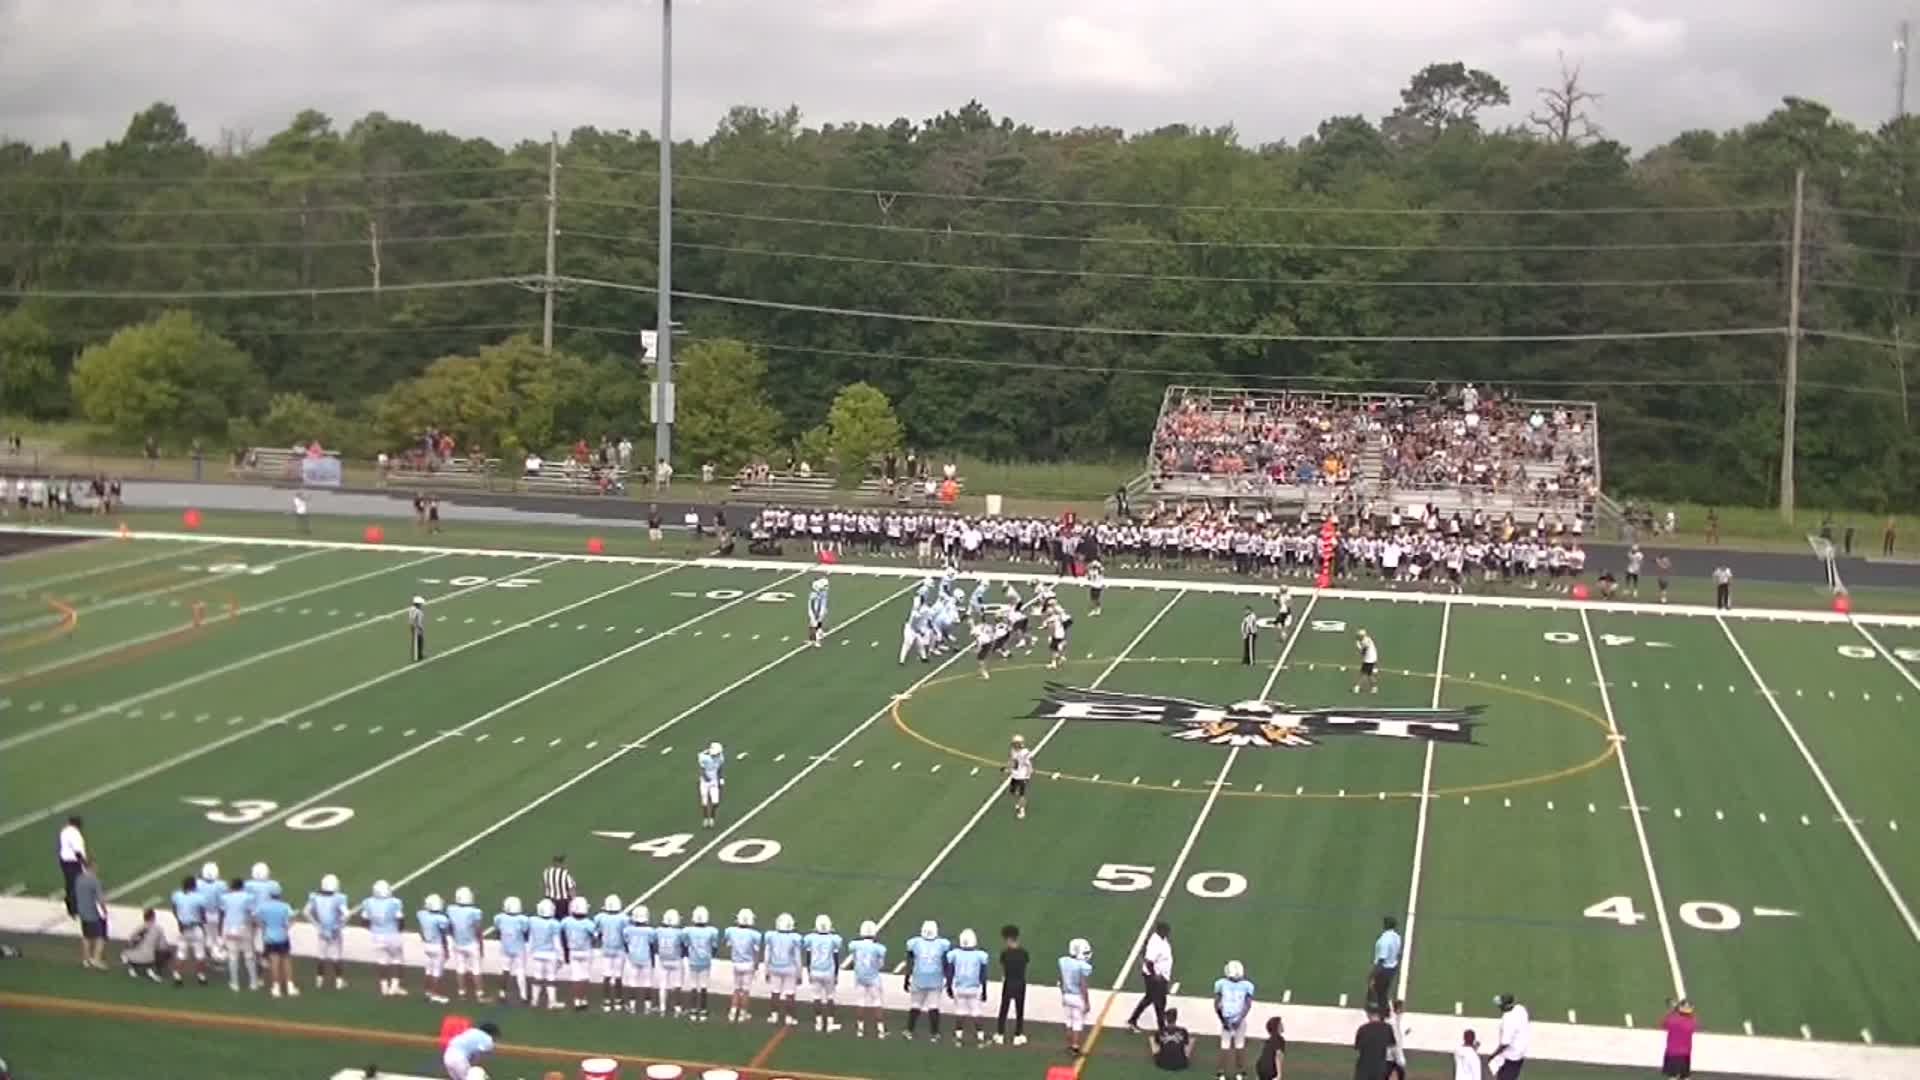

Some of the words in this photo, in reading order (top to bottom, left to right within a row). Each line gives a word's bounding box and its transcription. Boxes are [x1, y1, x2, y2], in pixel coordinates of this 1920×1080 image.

[206, 800, 354, 832] 30
[629, 833, 781, 865] 40
[1092, 863, 1248, 899] 50
[1583, 895, 1741, 930] 40
